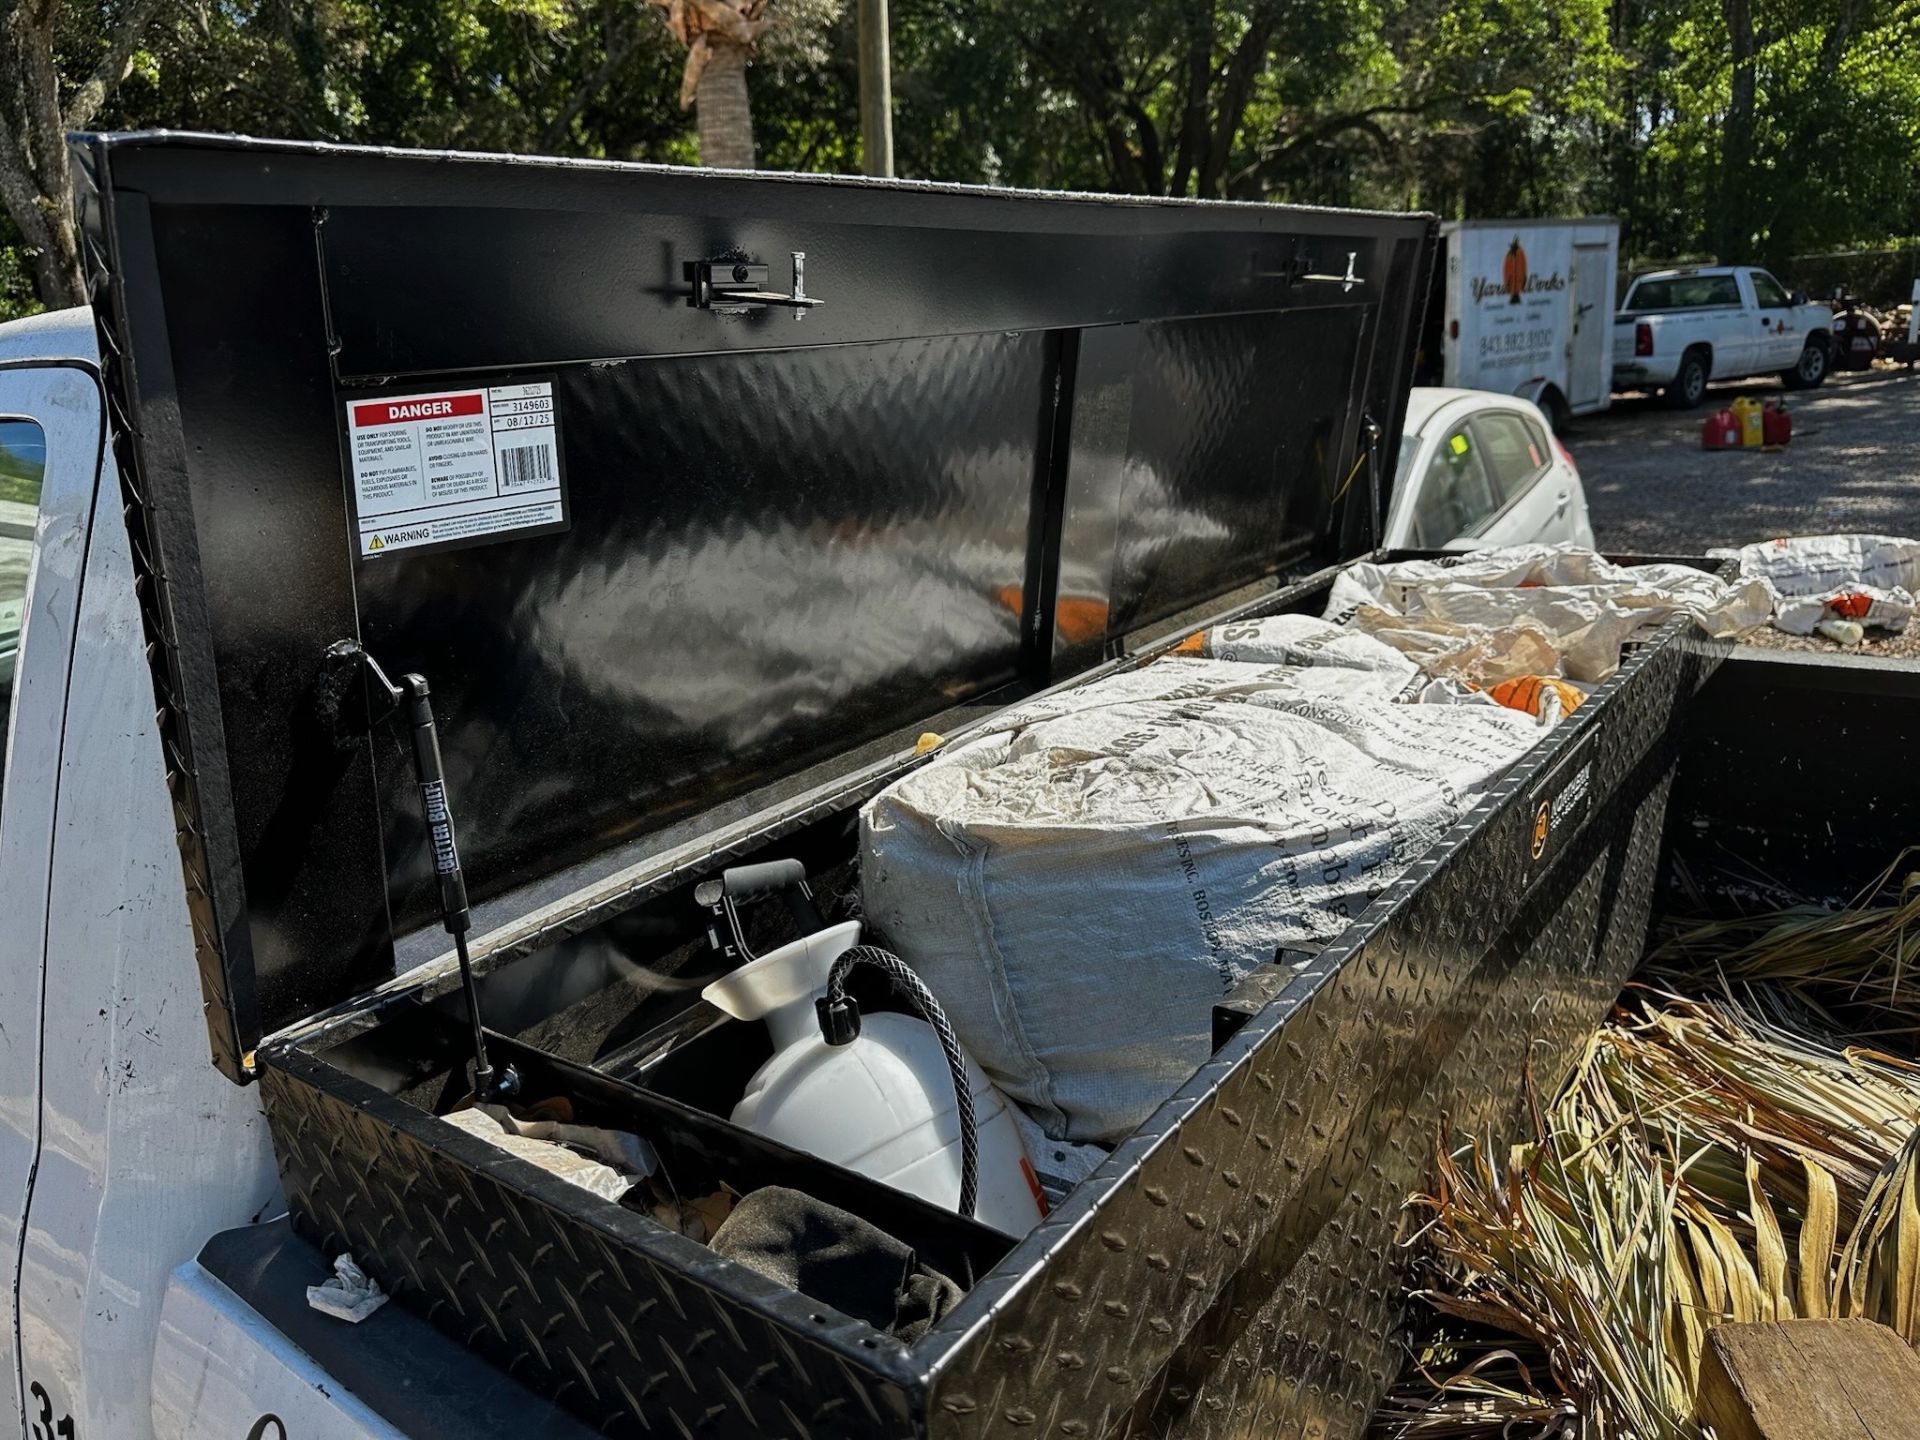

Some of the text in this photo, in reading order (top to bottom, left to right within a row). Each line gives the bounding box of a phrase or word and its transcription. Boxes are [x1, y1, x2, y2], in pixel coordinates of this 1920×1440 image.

[512, 398, 549, 411] 3149603
[388, 401, 452, 420] DANGER
[506, 413, 549, 427] 08/12/25
[388, 429, 407, 437] STORING
[458, 427, 484, 436] UNINTENDED
[364, 437, 396, 447] TRANSPORTING
[433, 437, 464, 446] UNREASONABLE
[394, 443, 411, 451] SIMILAR
[376, 474, 401, 483] EXPLOSIVES
[430, 475, 448, 483] BEWARE
[454, 471, 477, 479] POSSIBILITY
[361, 483, 388, 492] HAZARDOUS
[388, 480, 412, 489] MATERIALS
[431, 482, 445, 490] INJURY
[438, 488, 452, 496] MISUSE
[384, 528, 430, 545] WARNING
[425, 784, 455, 870] BETTER BUILT
